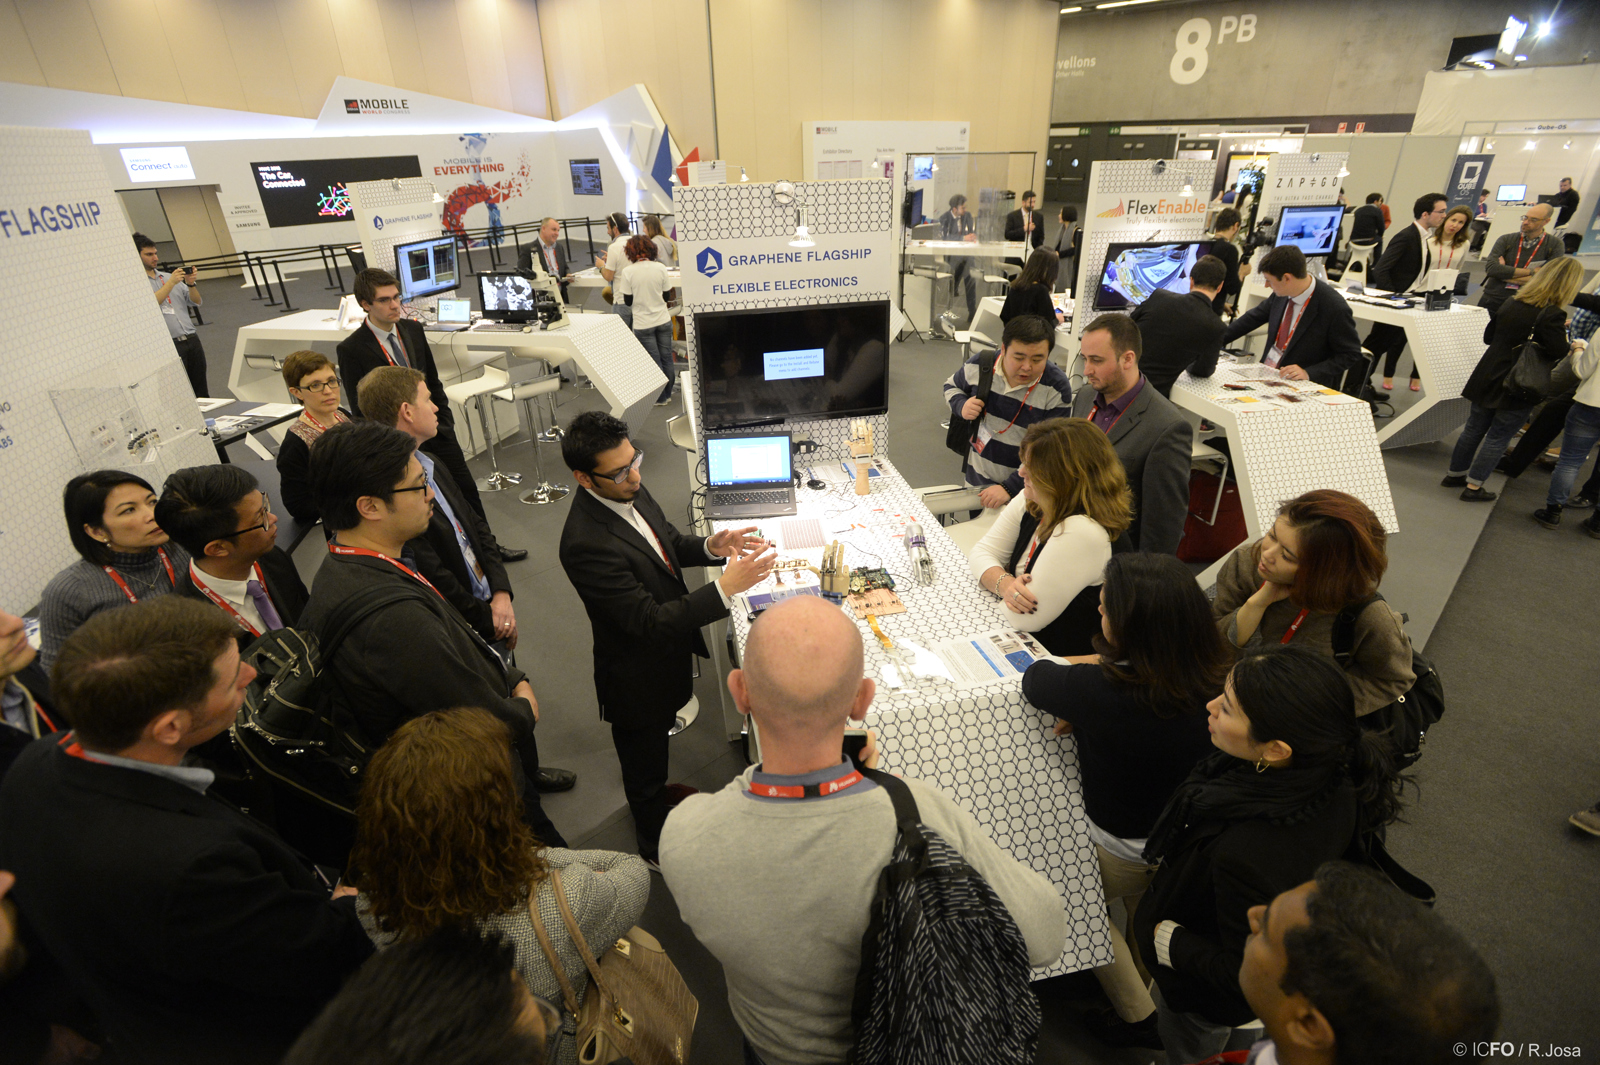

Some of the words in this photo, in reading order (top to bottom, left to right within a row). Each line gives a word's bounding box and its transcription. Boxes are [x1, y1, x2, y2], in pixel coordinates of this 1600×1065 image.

[1169, 17, 1212, 85] 8
[1217, 13, 1258, 45] PB
[1057, 55, 1097, 70] vellons
[359, 99, 409, 109] MOBILE
[130, 162, 172, 171] Connect
[443, 157, 481, 165] MOBILE
[259, 172, 277, 180] The
[433, 163, 505, 176] EVERYTHING
[262, 178, 306, 189] Connected
[1127, 198, 1206, 215] FlexEnable
[0, 201, 101, 238] FLAGSHIP
[384, 215, 411, 225] GRAPHENE
[411, 212, 433, 221] FLAGSHIP
[1126, 217, 1141, 226] Truly
[728, 252, 802, 266] GRAPHENE
[807, 248, 872, 262] FLAGSHIP
[713, 281, 771, 295] FLEXIBLE
[774, 276, 858, 291] ELECTRONICS
